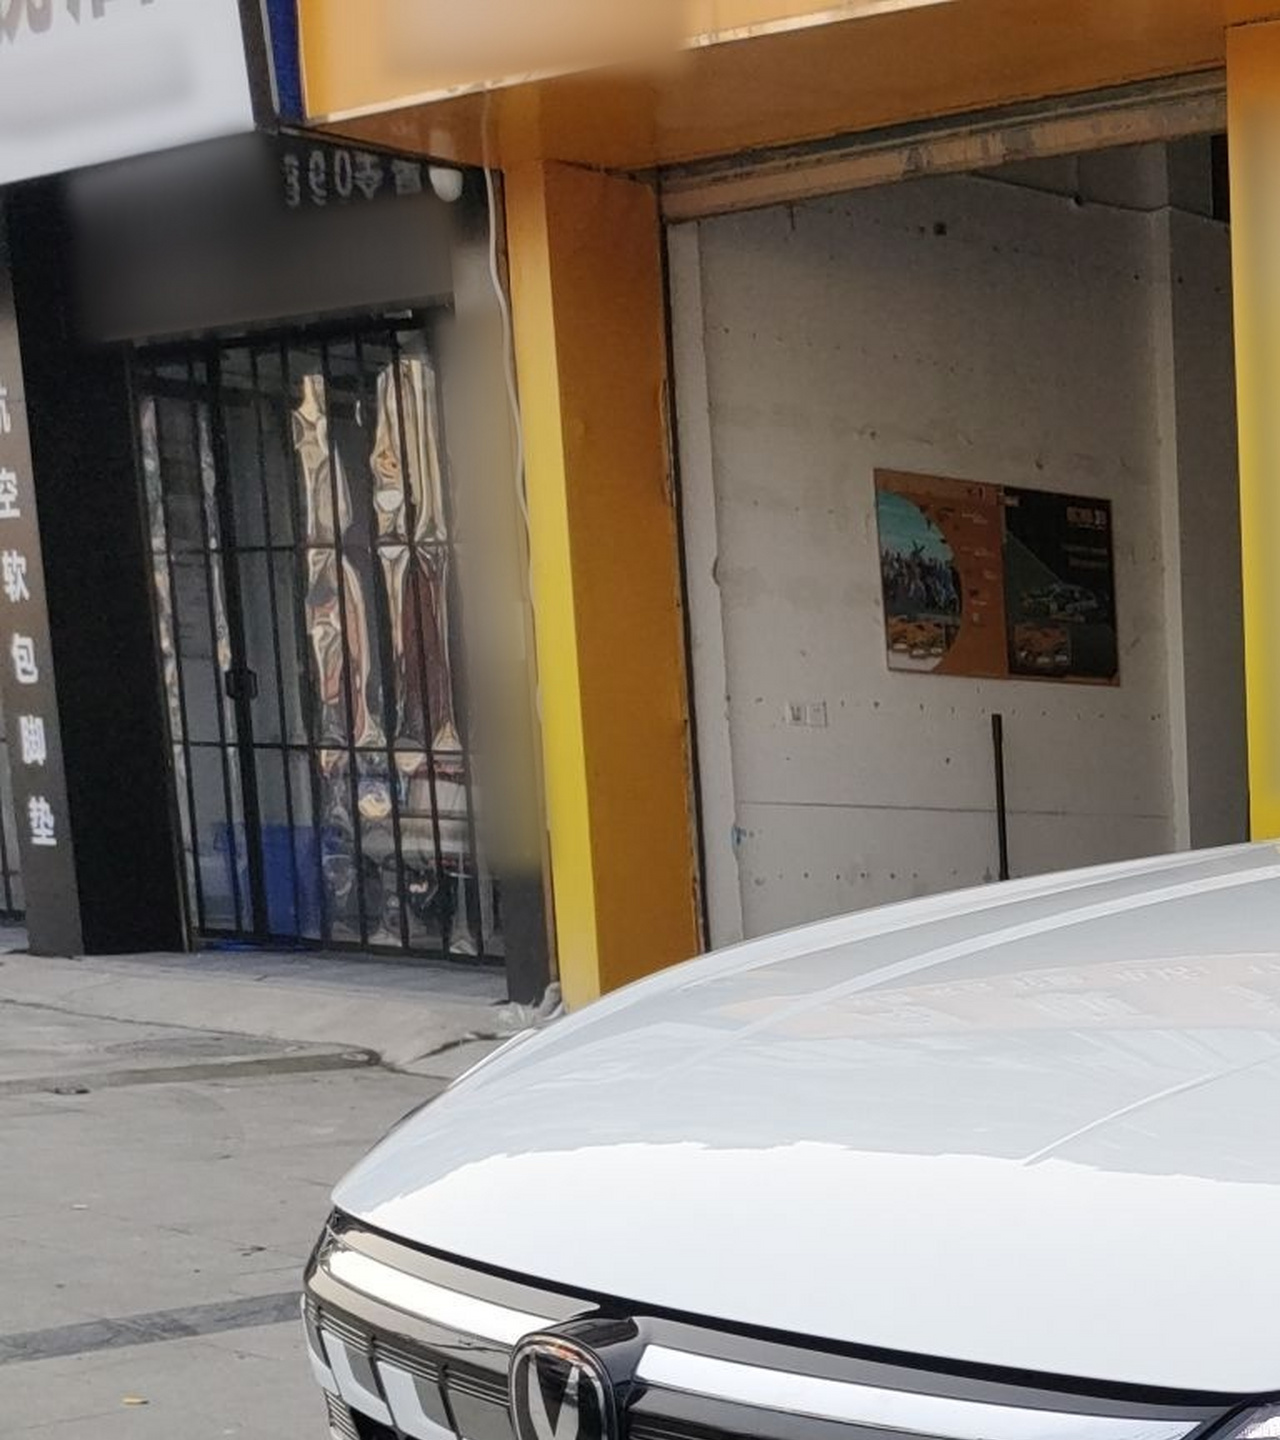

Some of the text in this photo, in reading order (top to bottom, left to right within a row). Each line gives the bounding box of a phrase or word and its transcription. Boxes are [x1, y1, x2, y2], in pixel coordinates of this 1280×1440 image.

[0, 387, 57, 847] 空软包脚垫
